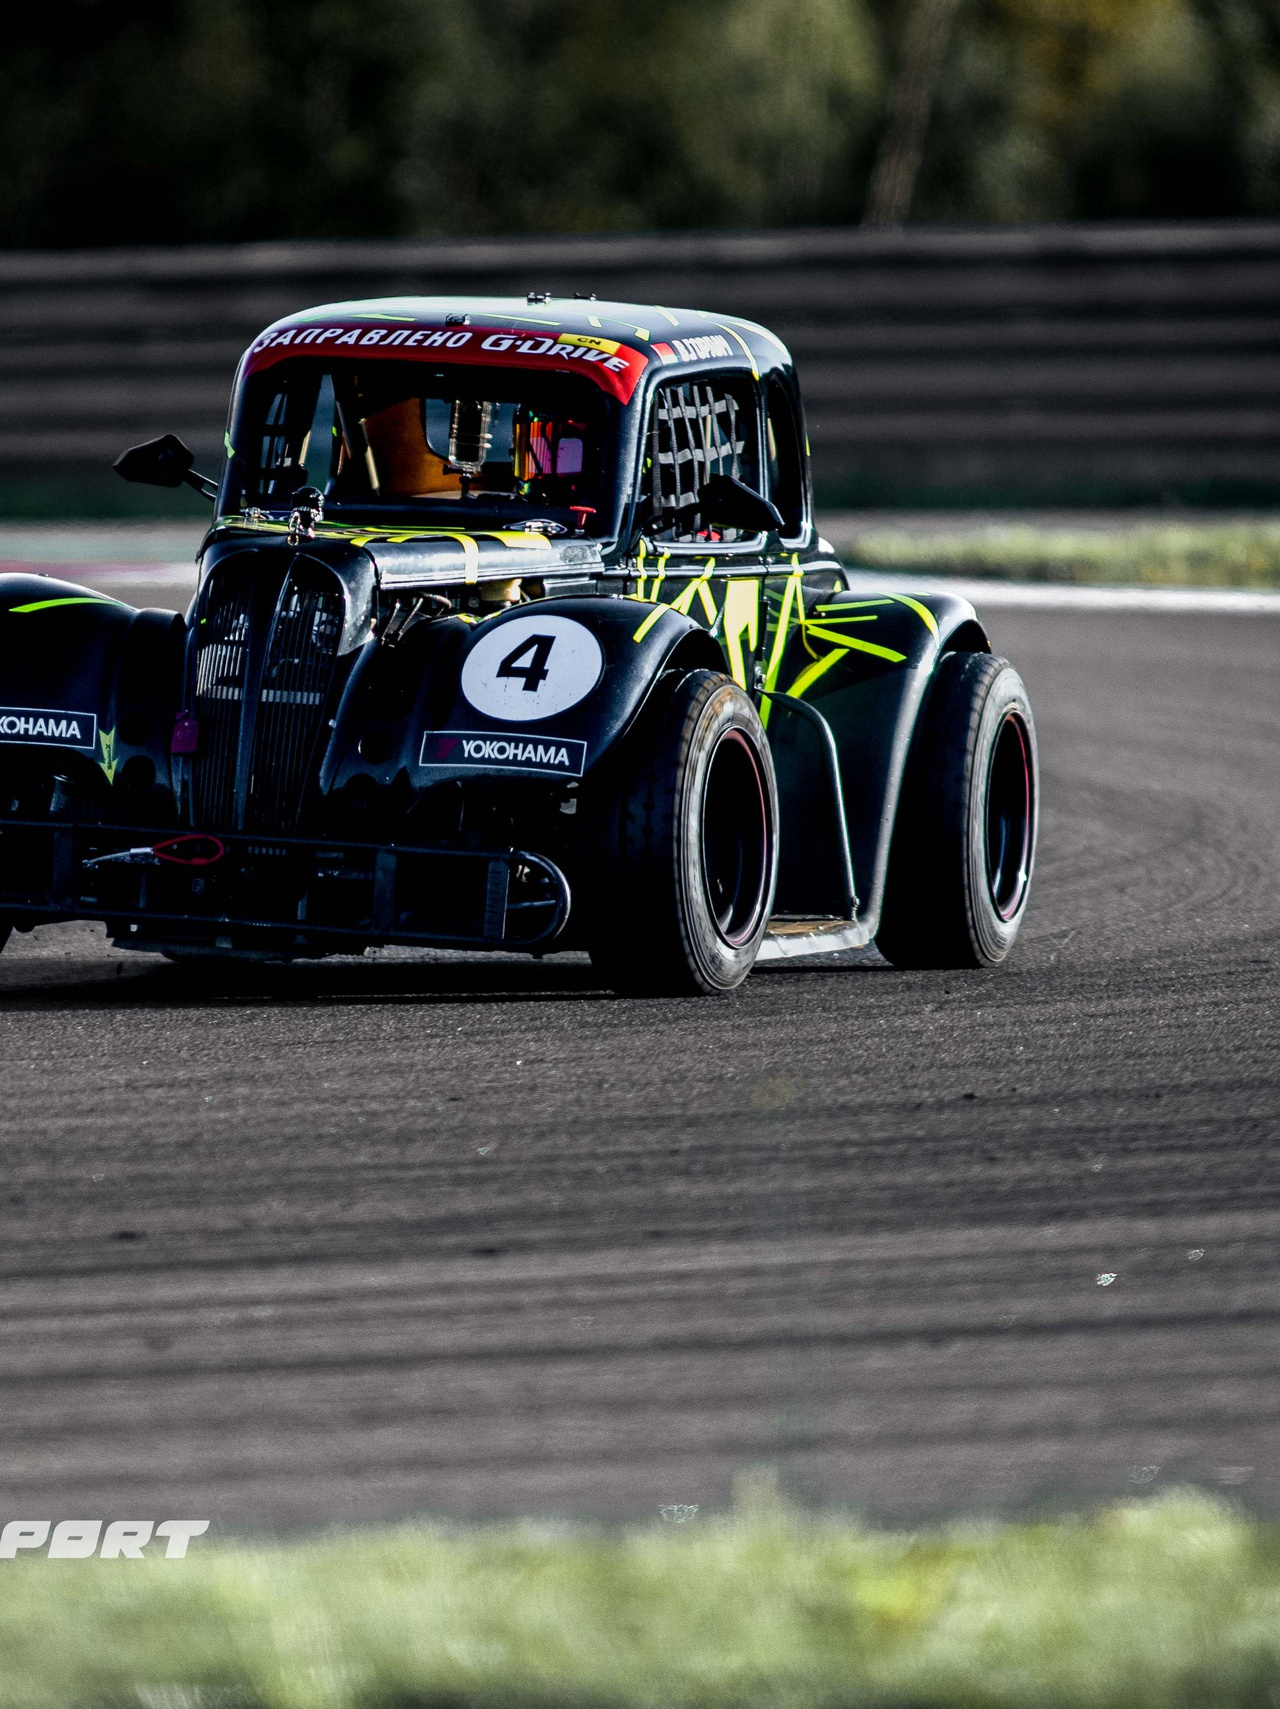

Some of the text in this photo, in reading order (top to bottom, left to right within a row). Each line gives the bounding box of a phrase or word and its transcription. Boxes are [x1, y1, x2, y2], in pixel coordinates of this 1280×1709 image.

[253, 328, 474, 353] ЗАПРАВЛЕНО
[577, 337, 601, 345] CN
[495, 633, 556, 692] 4
[462, 739, 569, 766] YOKOHAMA
